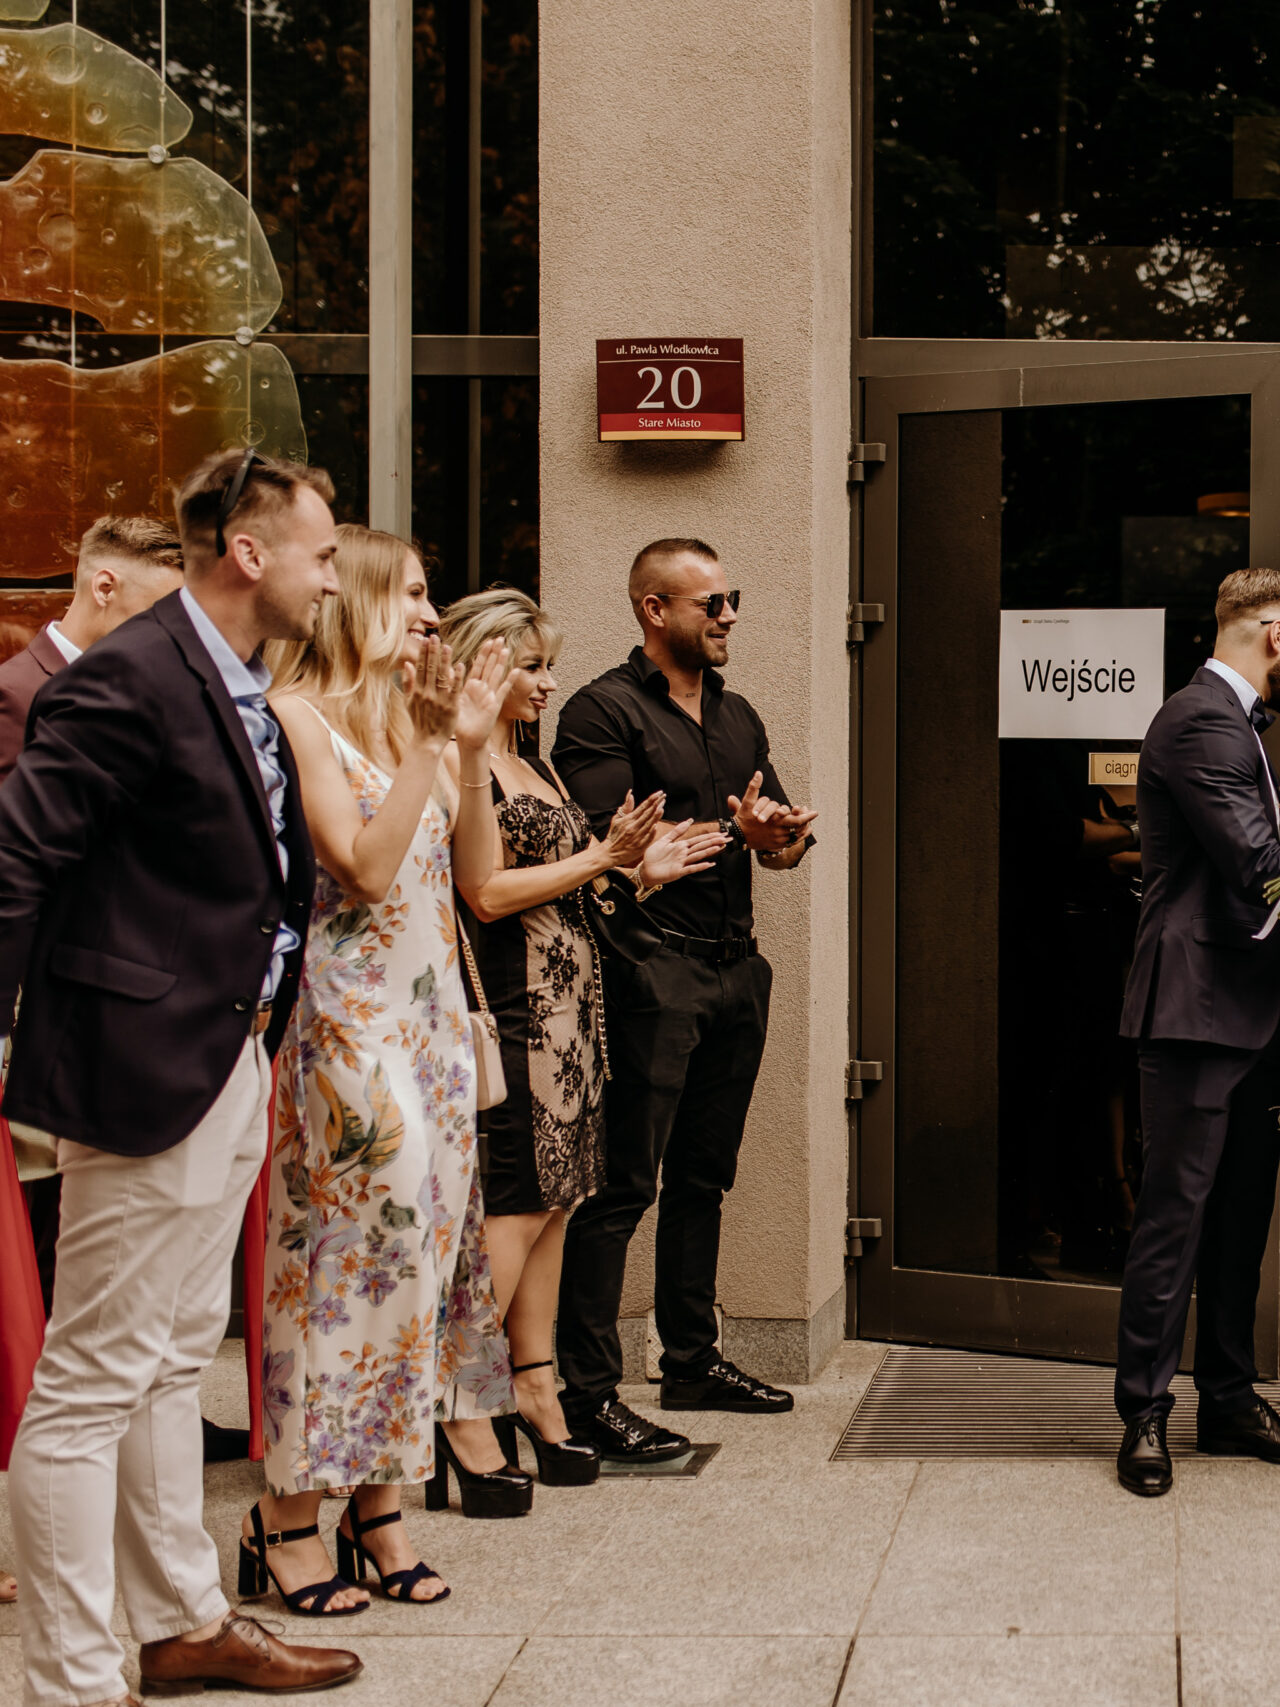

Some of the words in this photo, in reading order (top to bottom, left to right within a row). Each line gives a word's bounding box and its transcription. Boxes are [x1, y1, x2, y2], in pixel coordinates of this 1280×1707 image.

[616, 346, 627, 355] ul.
[630, 345, 657, 354] Pawła
[660, 344, 719, 355] Włodkowica
[636, 366, 702, 409] 20
[638, 418, 664, 428] Stare
[666, 418, 701, 428] Miasto
[1022, 659, 1135, 701] Wejście
[1105, 760, 1136, 777] ciągn
